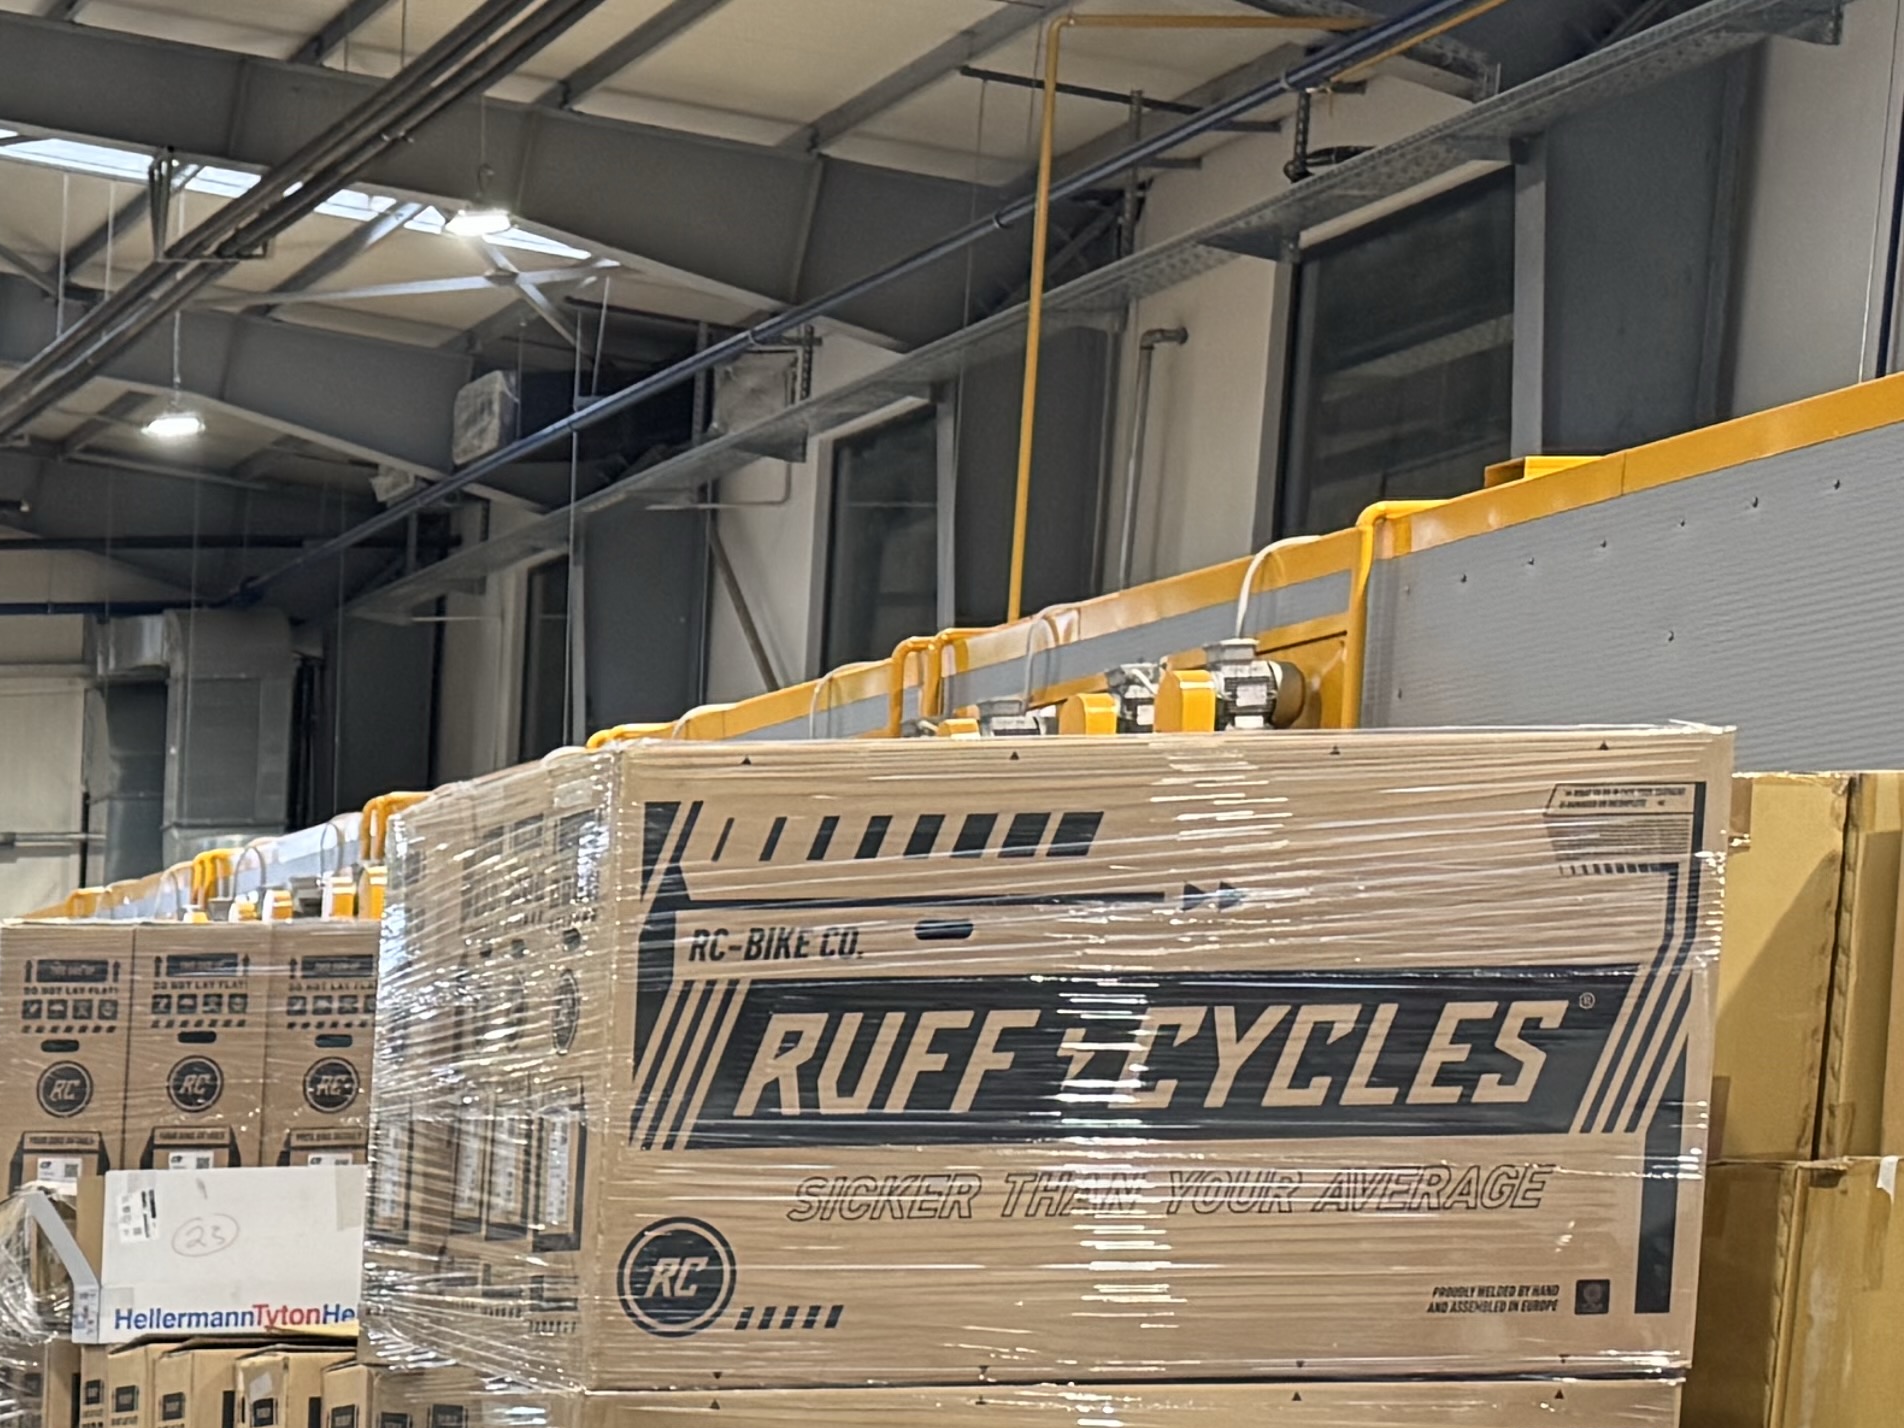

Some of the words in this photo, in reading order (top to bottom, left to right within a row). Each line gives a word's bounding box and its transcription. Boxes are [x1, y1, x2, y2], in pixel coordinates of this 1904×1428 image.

[689, 927, 813, 962] RC-BIKE
[819, 927, 864, 960] CO.
[733, 1010, 1040, 1117] RUFF
[1109, 999, 1569, 1109] CYCLES
[786, 1174, 983, 1222] SICKER
[1166, 1169, 1303, 1215] YOUR
[1311, 1163, 1555, 1213] AVERAGE
[643, 1256, 710, 1299] RC
